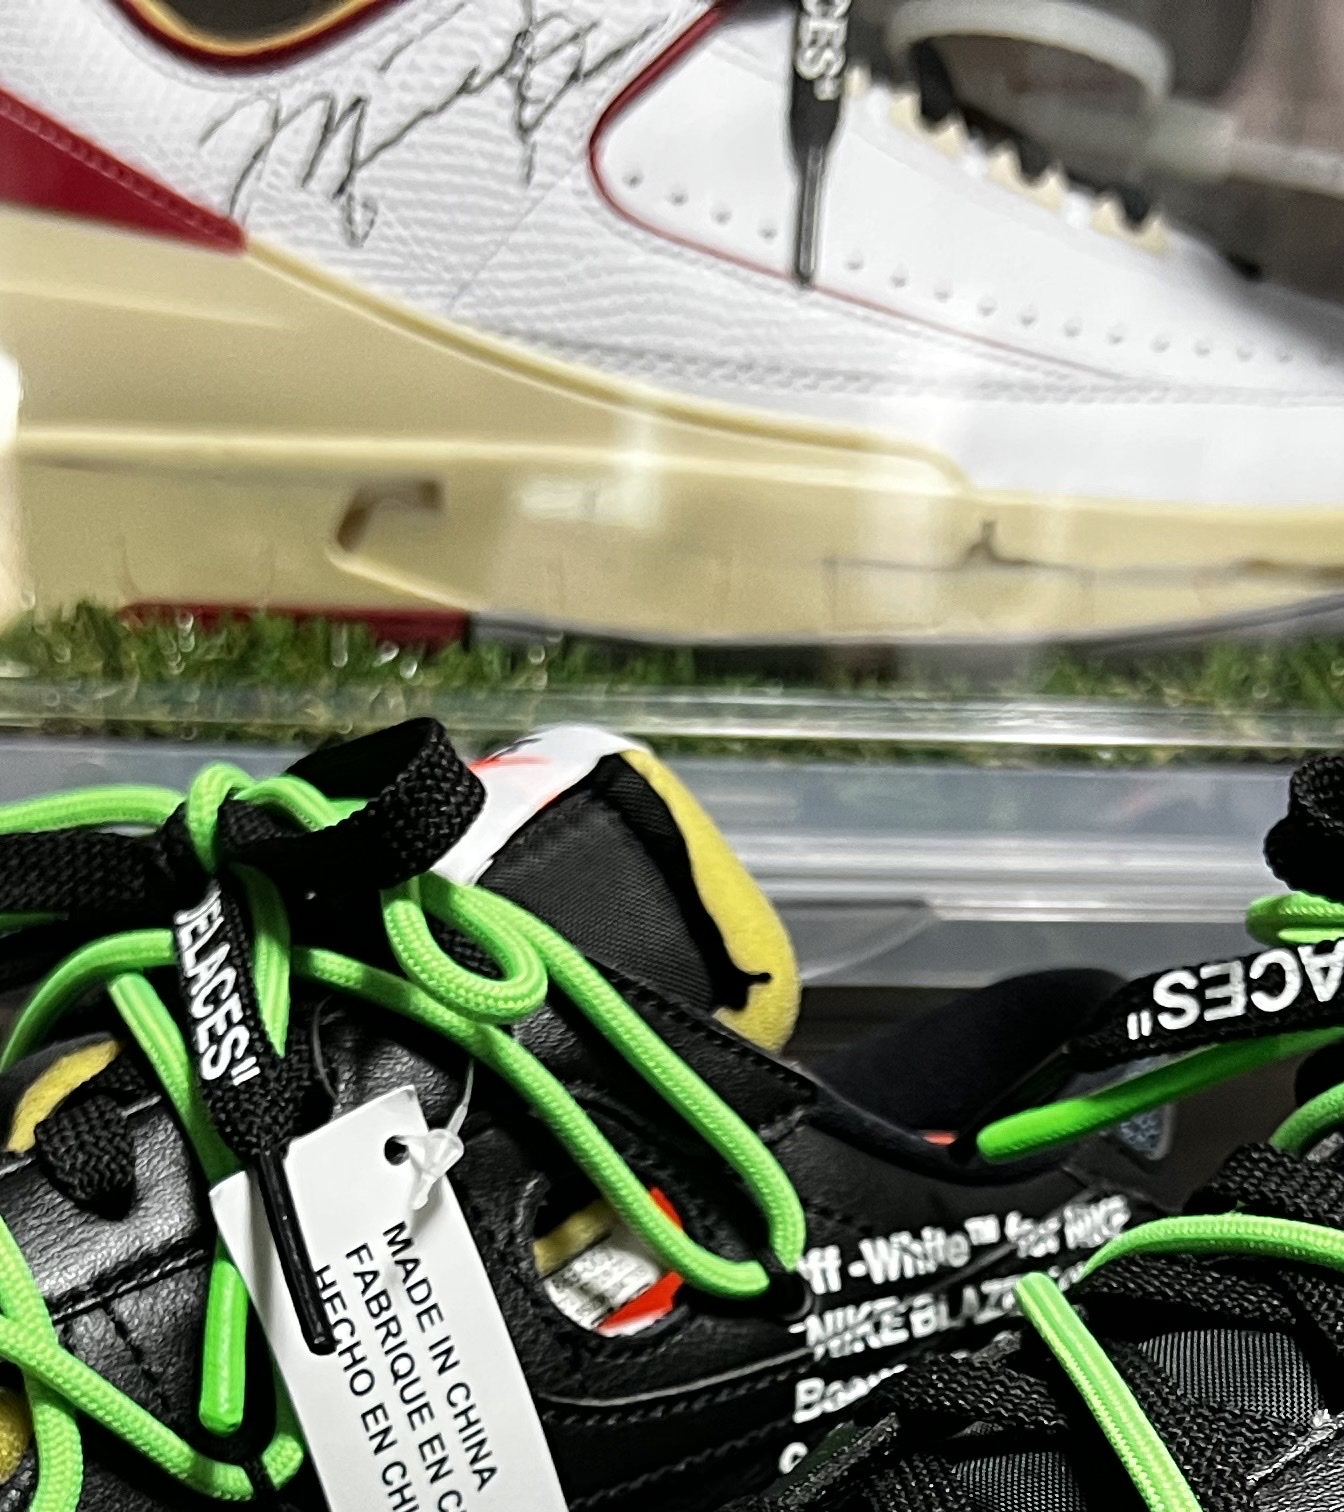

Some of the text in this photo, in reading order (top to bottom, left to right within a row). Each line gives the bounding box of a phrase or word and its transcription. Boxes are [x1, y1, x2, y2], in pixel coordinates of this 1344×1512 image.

[314, 1264, 375, 1396] HECHO
[360, 1402, 397, 1455] EN
[346, 1243, 435, 1431] FABRIQUE
[418, 1433, 454, 1484] EN
[383, 1221, 498, 1492] MADE IN CHINA
